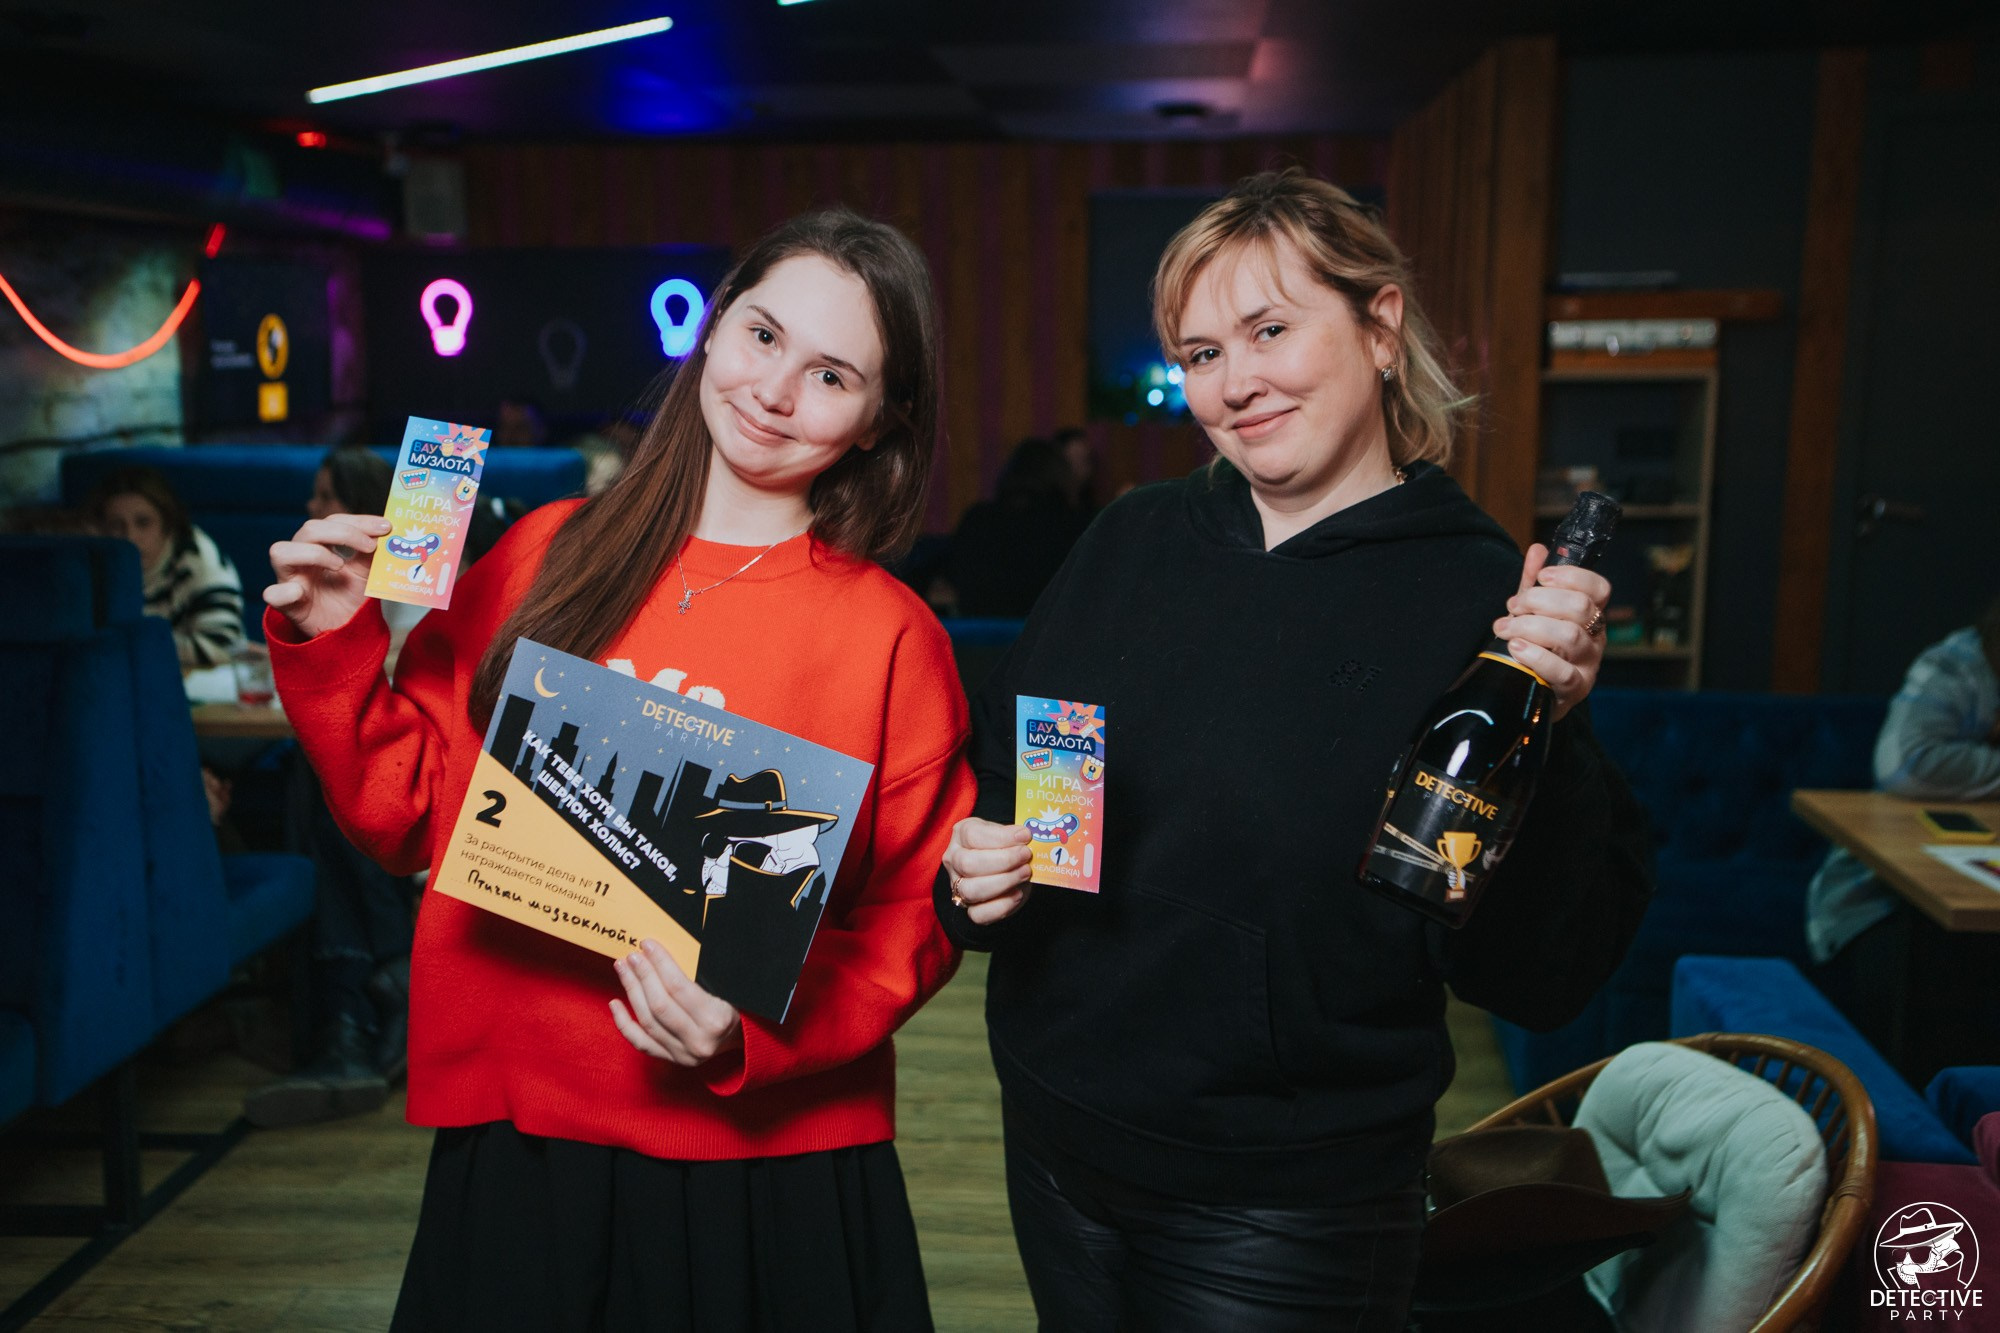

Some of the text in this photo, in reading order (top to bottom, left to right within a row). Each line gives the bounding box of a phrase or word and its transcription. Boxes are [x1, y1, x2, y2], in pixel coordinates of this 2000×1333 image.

[414, 441, 436, 455] ВАУ
[410, 452, 471, 473] МУЗЛОТА
[409, 492, 452, 513] ИГРА
[395, 507, 461, 528] В ПОДАРОК
[641, 699, 736, 747] DETECTIVE
[1029, 721, 1054, 734] ВАУ
[653, 722, 714, 752] PARTY
[1029, 732, 1092, 752] МУЗЛОТА
[1038, 774, 1083, 792] ИГРА
[1414, 770, 1499, 821] DETECTIVE
[475, 789, 507, 829] 2
[522, 729, 679, 883] КАК ТЕБЕ ХОТЯ БЫ ТАКОЕ,
[1026, 789, 1095, 807] В ПОДАРОК
[1423, 791, 1479, 824] PRY
[537, 769, 642, 871] ШЕРЛОК ХОЛМС?
[464, 832, 479, 846] За
[481, 840, 546, 872] раскрытие
[546, 865, 577, 884] дела
[594, 880, 610, 897] 11
[1036, 847, 1063, 866] НА 1
[460, 849, 596, 908] награждается команда
[1033, 864, 1080, 878] ЧЕЛОВЕК(А)
[467, 869, 639, 948] Птички мозгоклюйк
